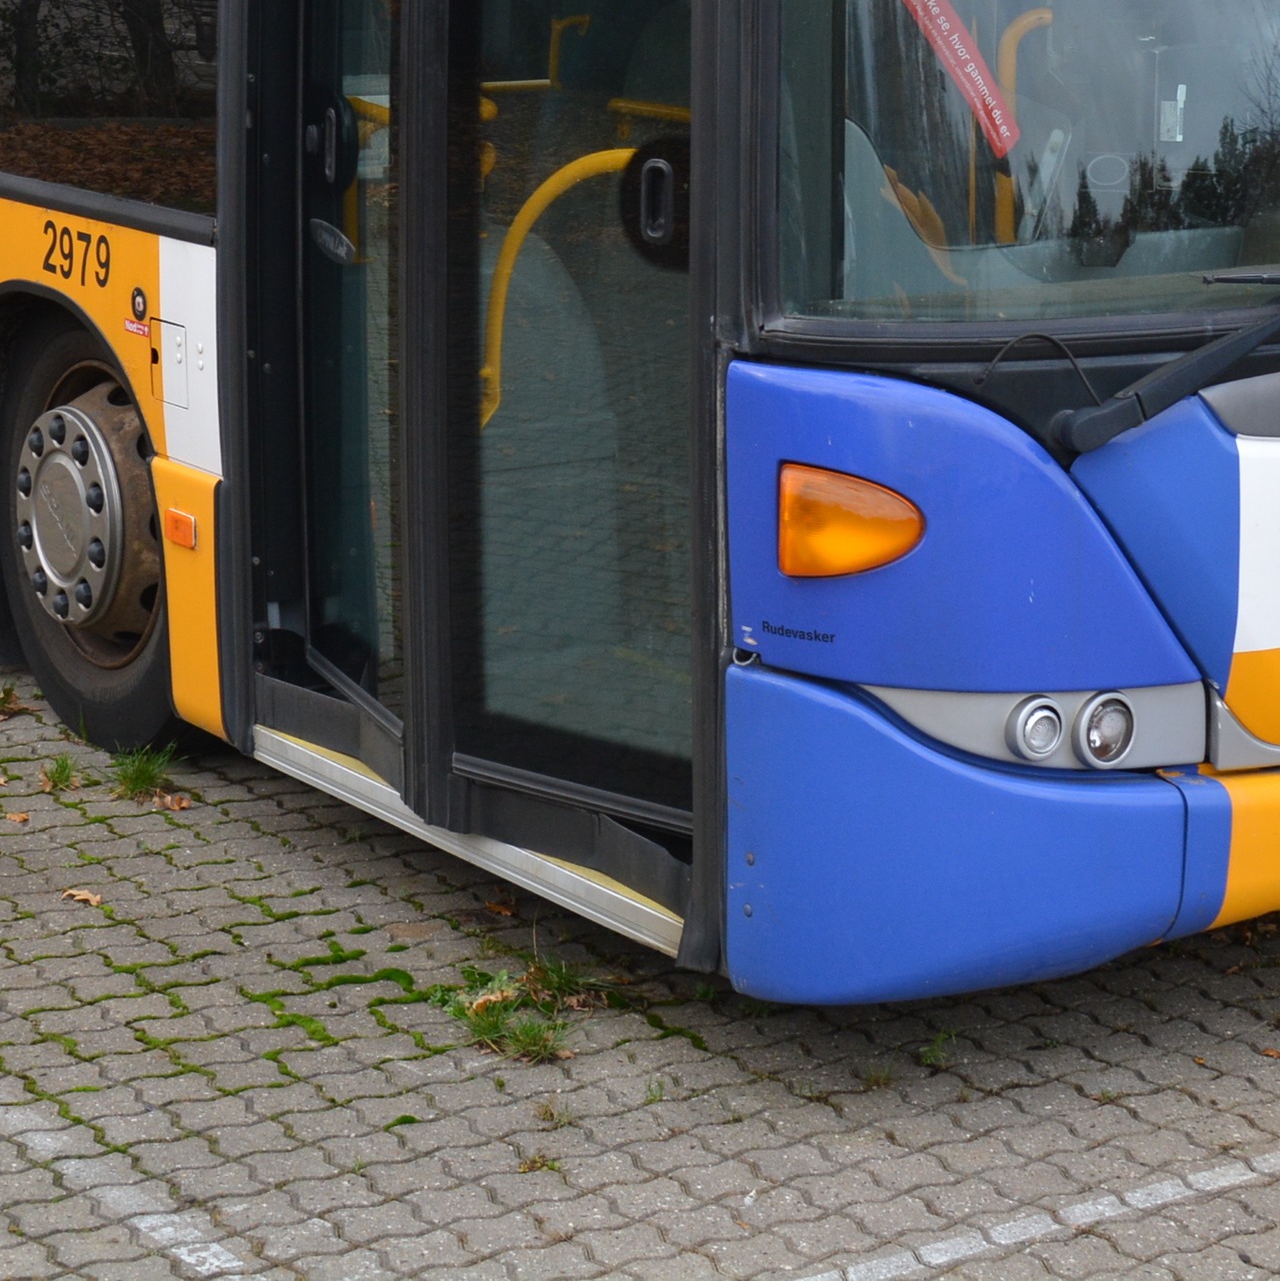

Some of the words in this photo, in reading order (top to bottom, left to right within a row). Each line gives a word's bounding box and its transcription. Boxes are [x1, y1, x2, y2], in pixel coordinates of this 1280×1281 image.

[937, 15, 951, 36] se,
[949, 33, 971, 61] hvor
[964, 62, 997, 110] gammel
[991, 107, 1004, 125] du
[1000, 125, 1011, 138] er
[43, 220, 110, 288] 2979
[762, 621, 836, 643] Rudevasker
